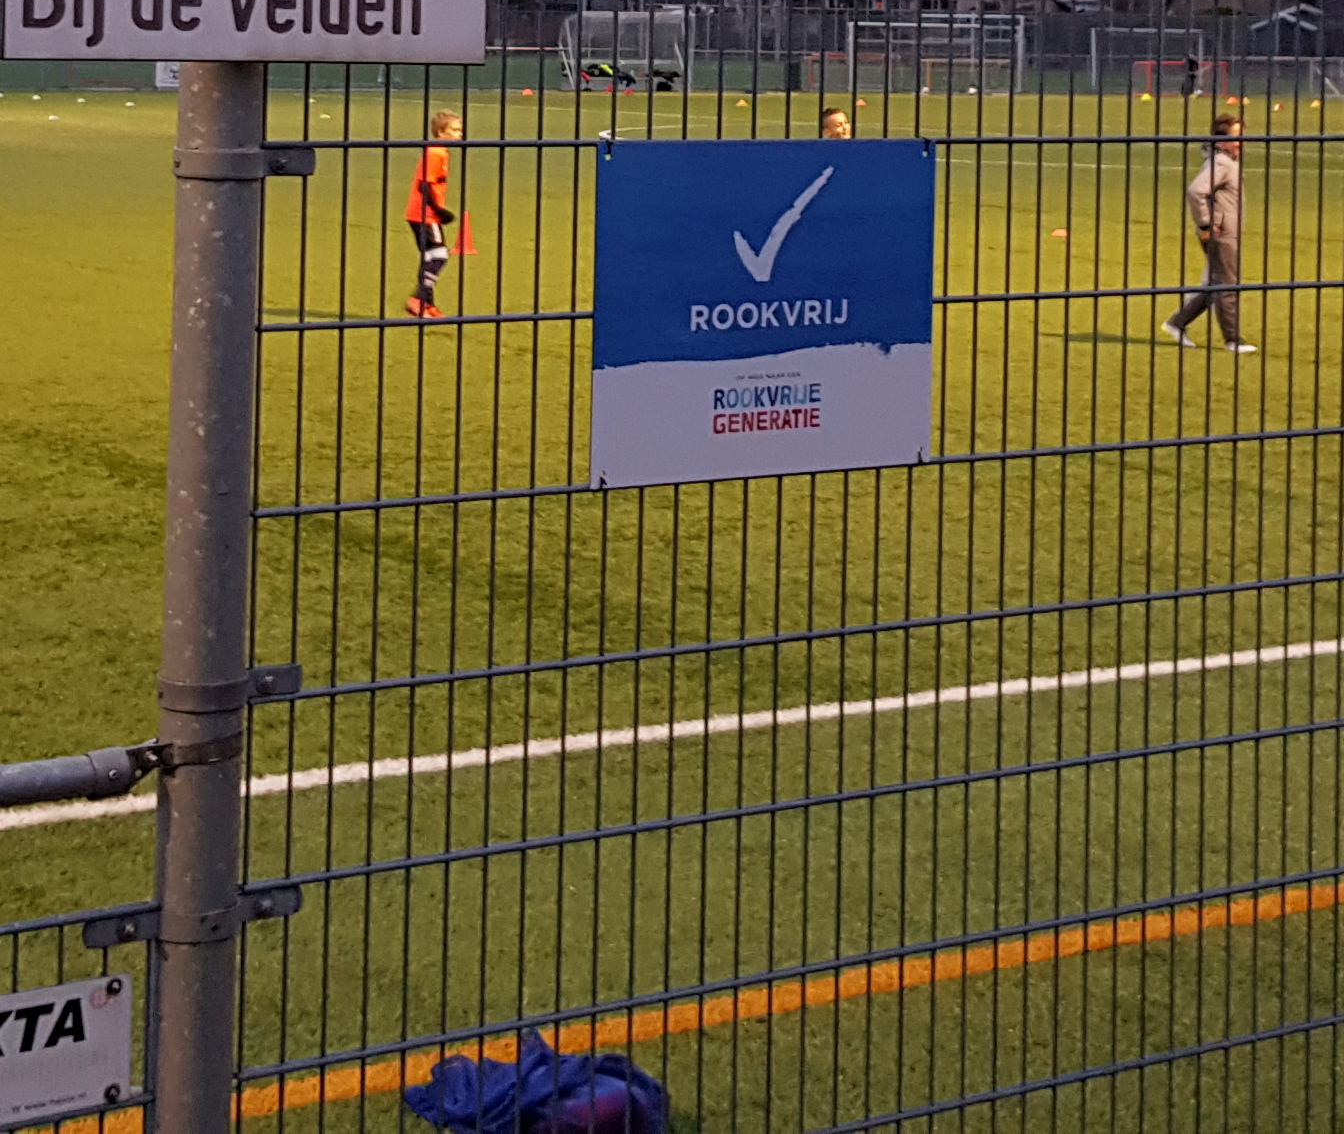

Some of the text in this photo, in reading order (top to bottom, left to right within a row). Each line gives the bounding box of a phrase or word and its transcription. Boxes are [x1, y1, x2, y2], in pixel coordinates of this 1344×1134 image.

[689, 299, 849, 332] ROOKVRIJ
[713, 382, 822, 410] ROOKVRIJE
[712, 407, 821, 435] GENERATIE
